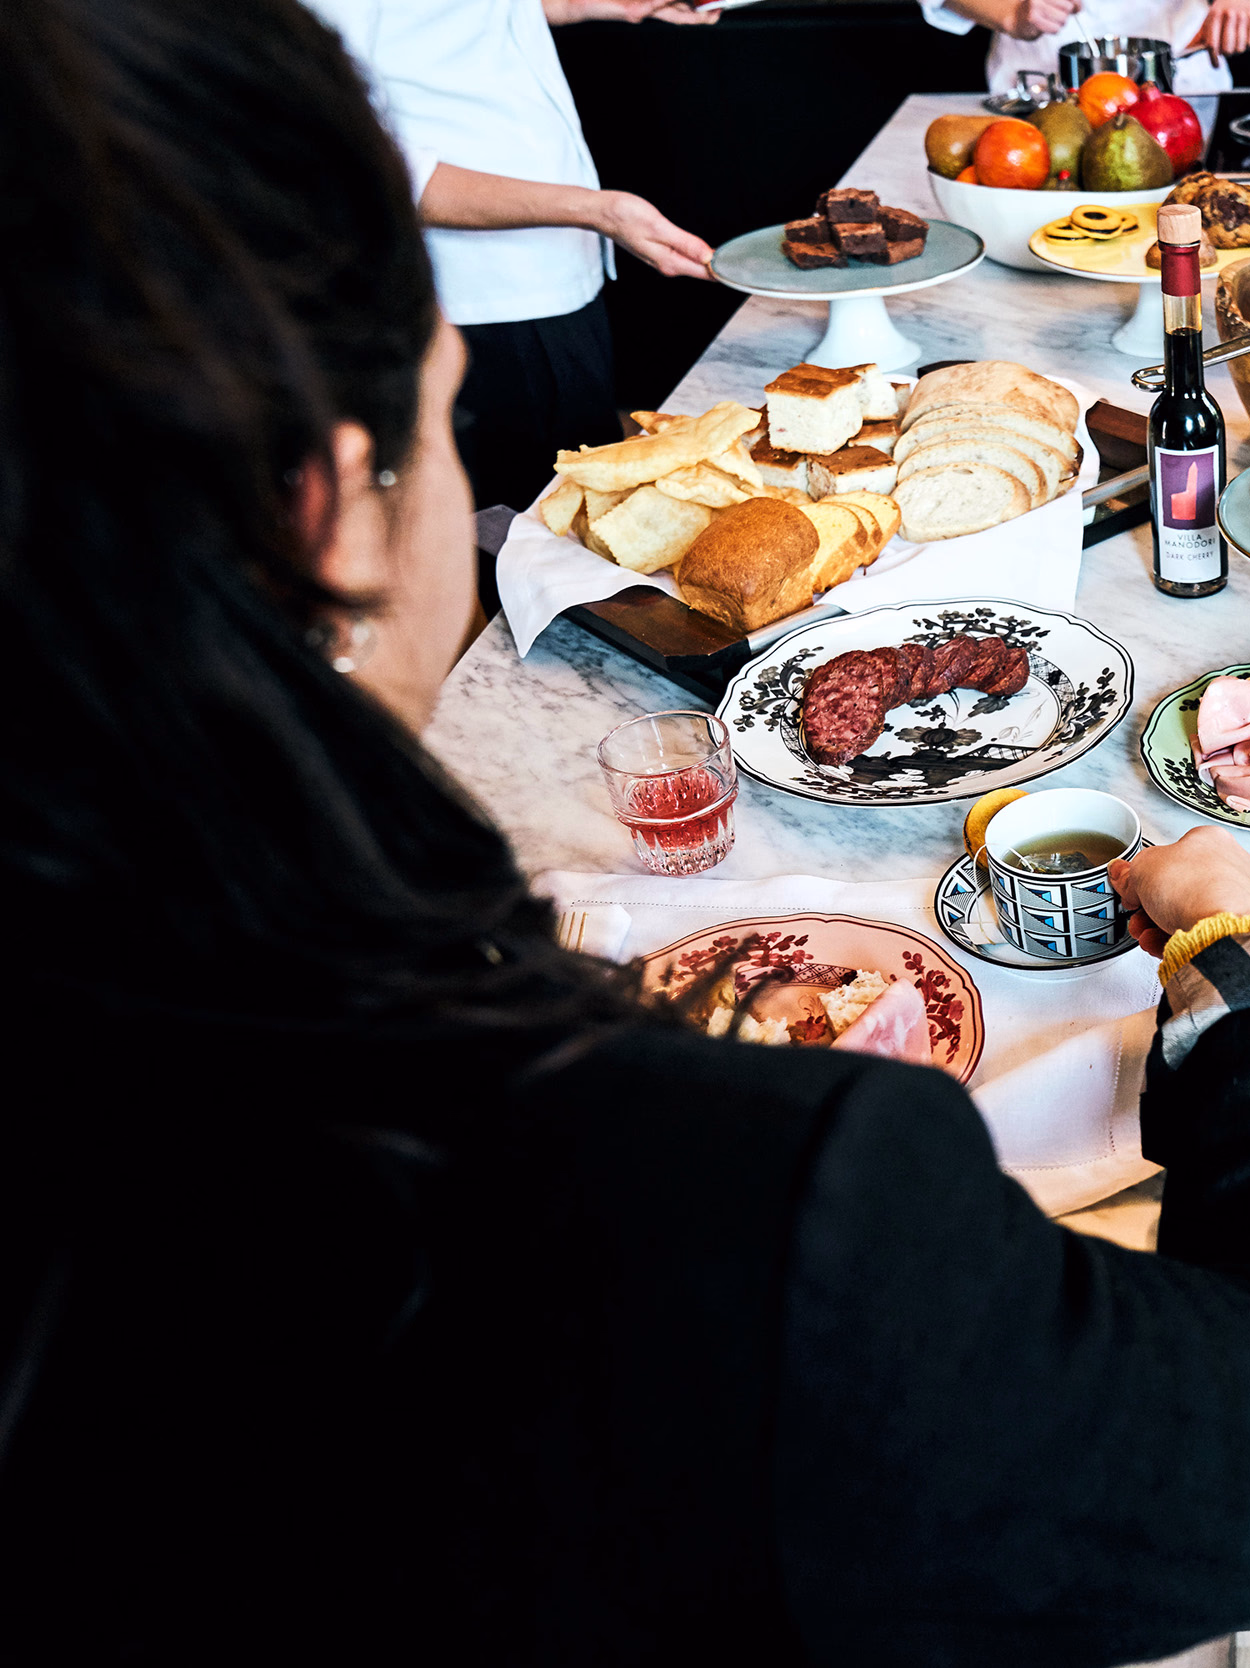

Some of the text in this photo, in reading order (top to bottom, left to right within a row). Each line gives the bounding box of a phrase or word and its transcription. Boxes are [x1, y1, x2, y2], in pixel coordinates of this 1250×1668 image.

[1177, 533, 1202, 541] VILLA
[1164, 538, 1216, 549] MANODORI
[1166, 551, 1214, 561] DARK CHERRY
